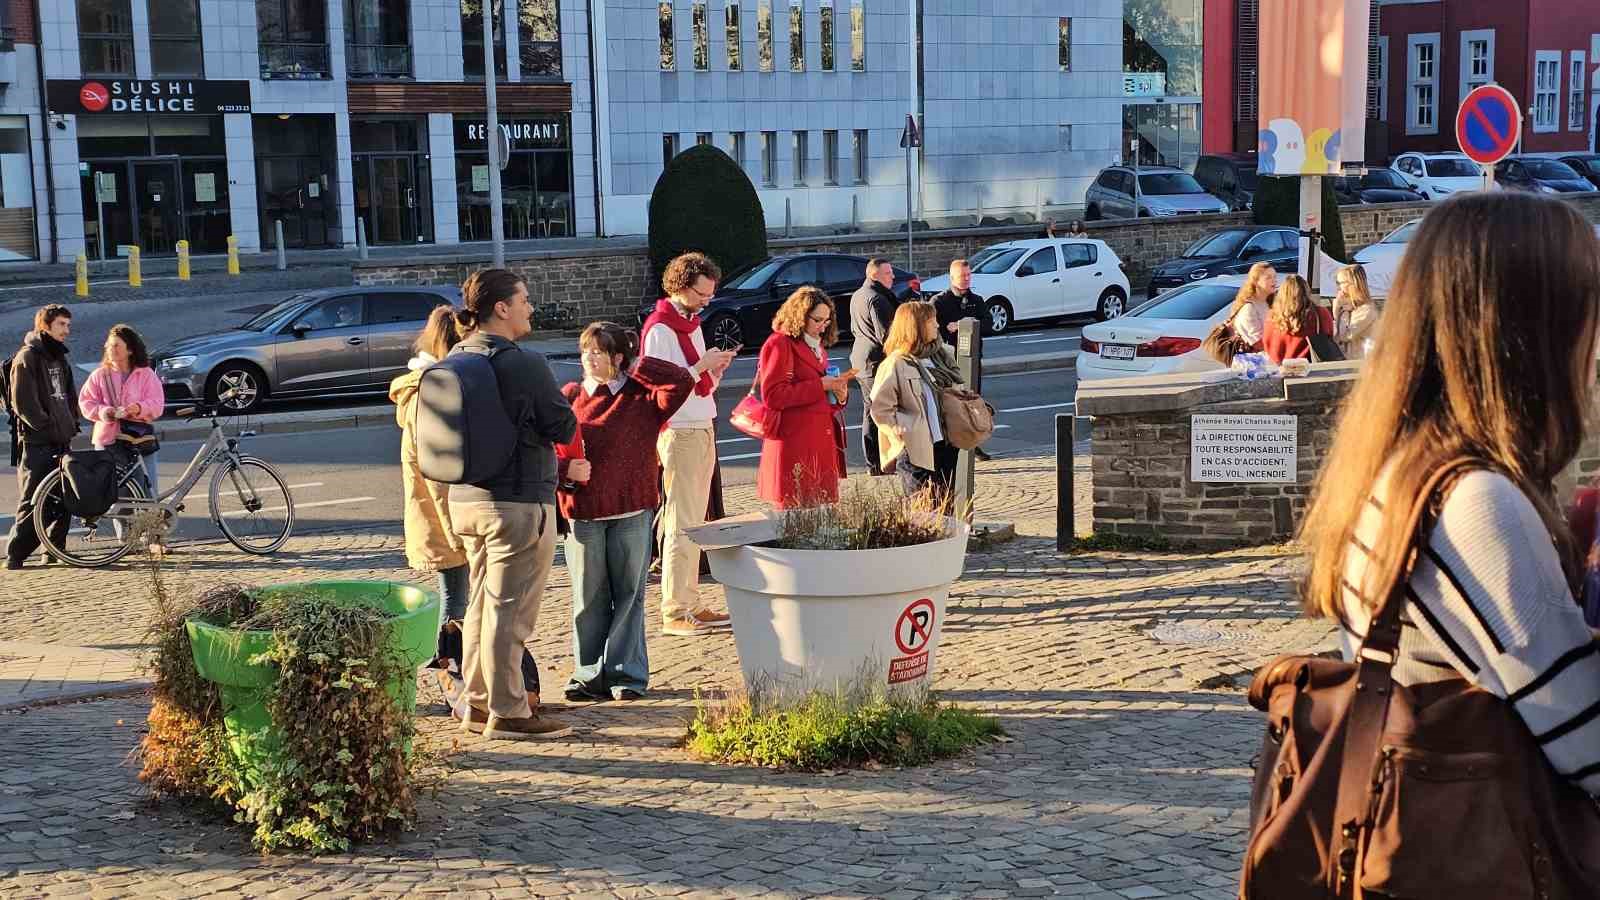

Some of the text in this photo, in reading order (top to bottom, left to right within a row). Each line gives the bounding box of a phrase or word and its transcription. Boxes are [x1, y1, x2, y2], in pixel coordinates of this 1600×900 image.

[112, 82, 193, 95] SUSHI
[112, 95, 195, 112] DÉLICE
[468, 123, 560, 140] REAURANT
[1196, 433, 1207, 441] LA
[1209, 433, 1254, 441] DIRECTION
[1195, 446, 1221, 454] TOUTE
[1201, 458, 1213, 466] EN
[1215, 458, 1233, 466] CAS
[1246, 470, 1287, 479] INCENDIE
